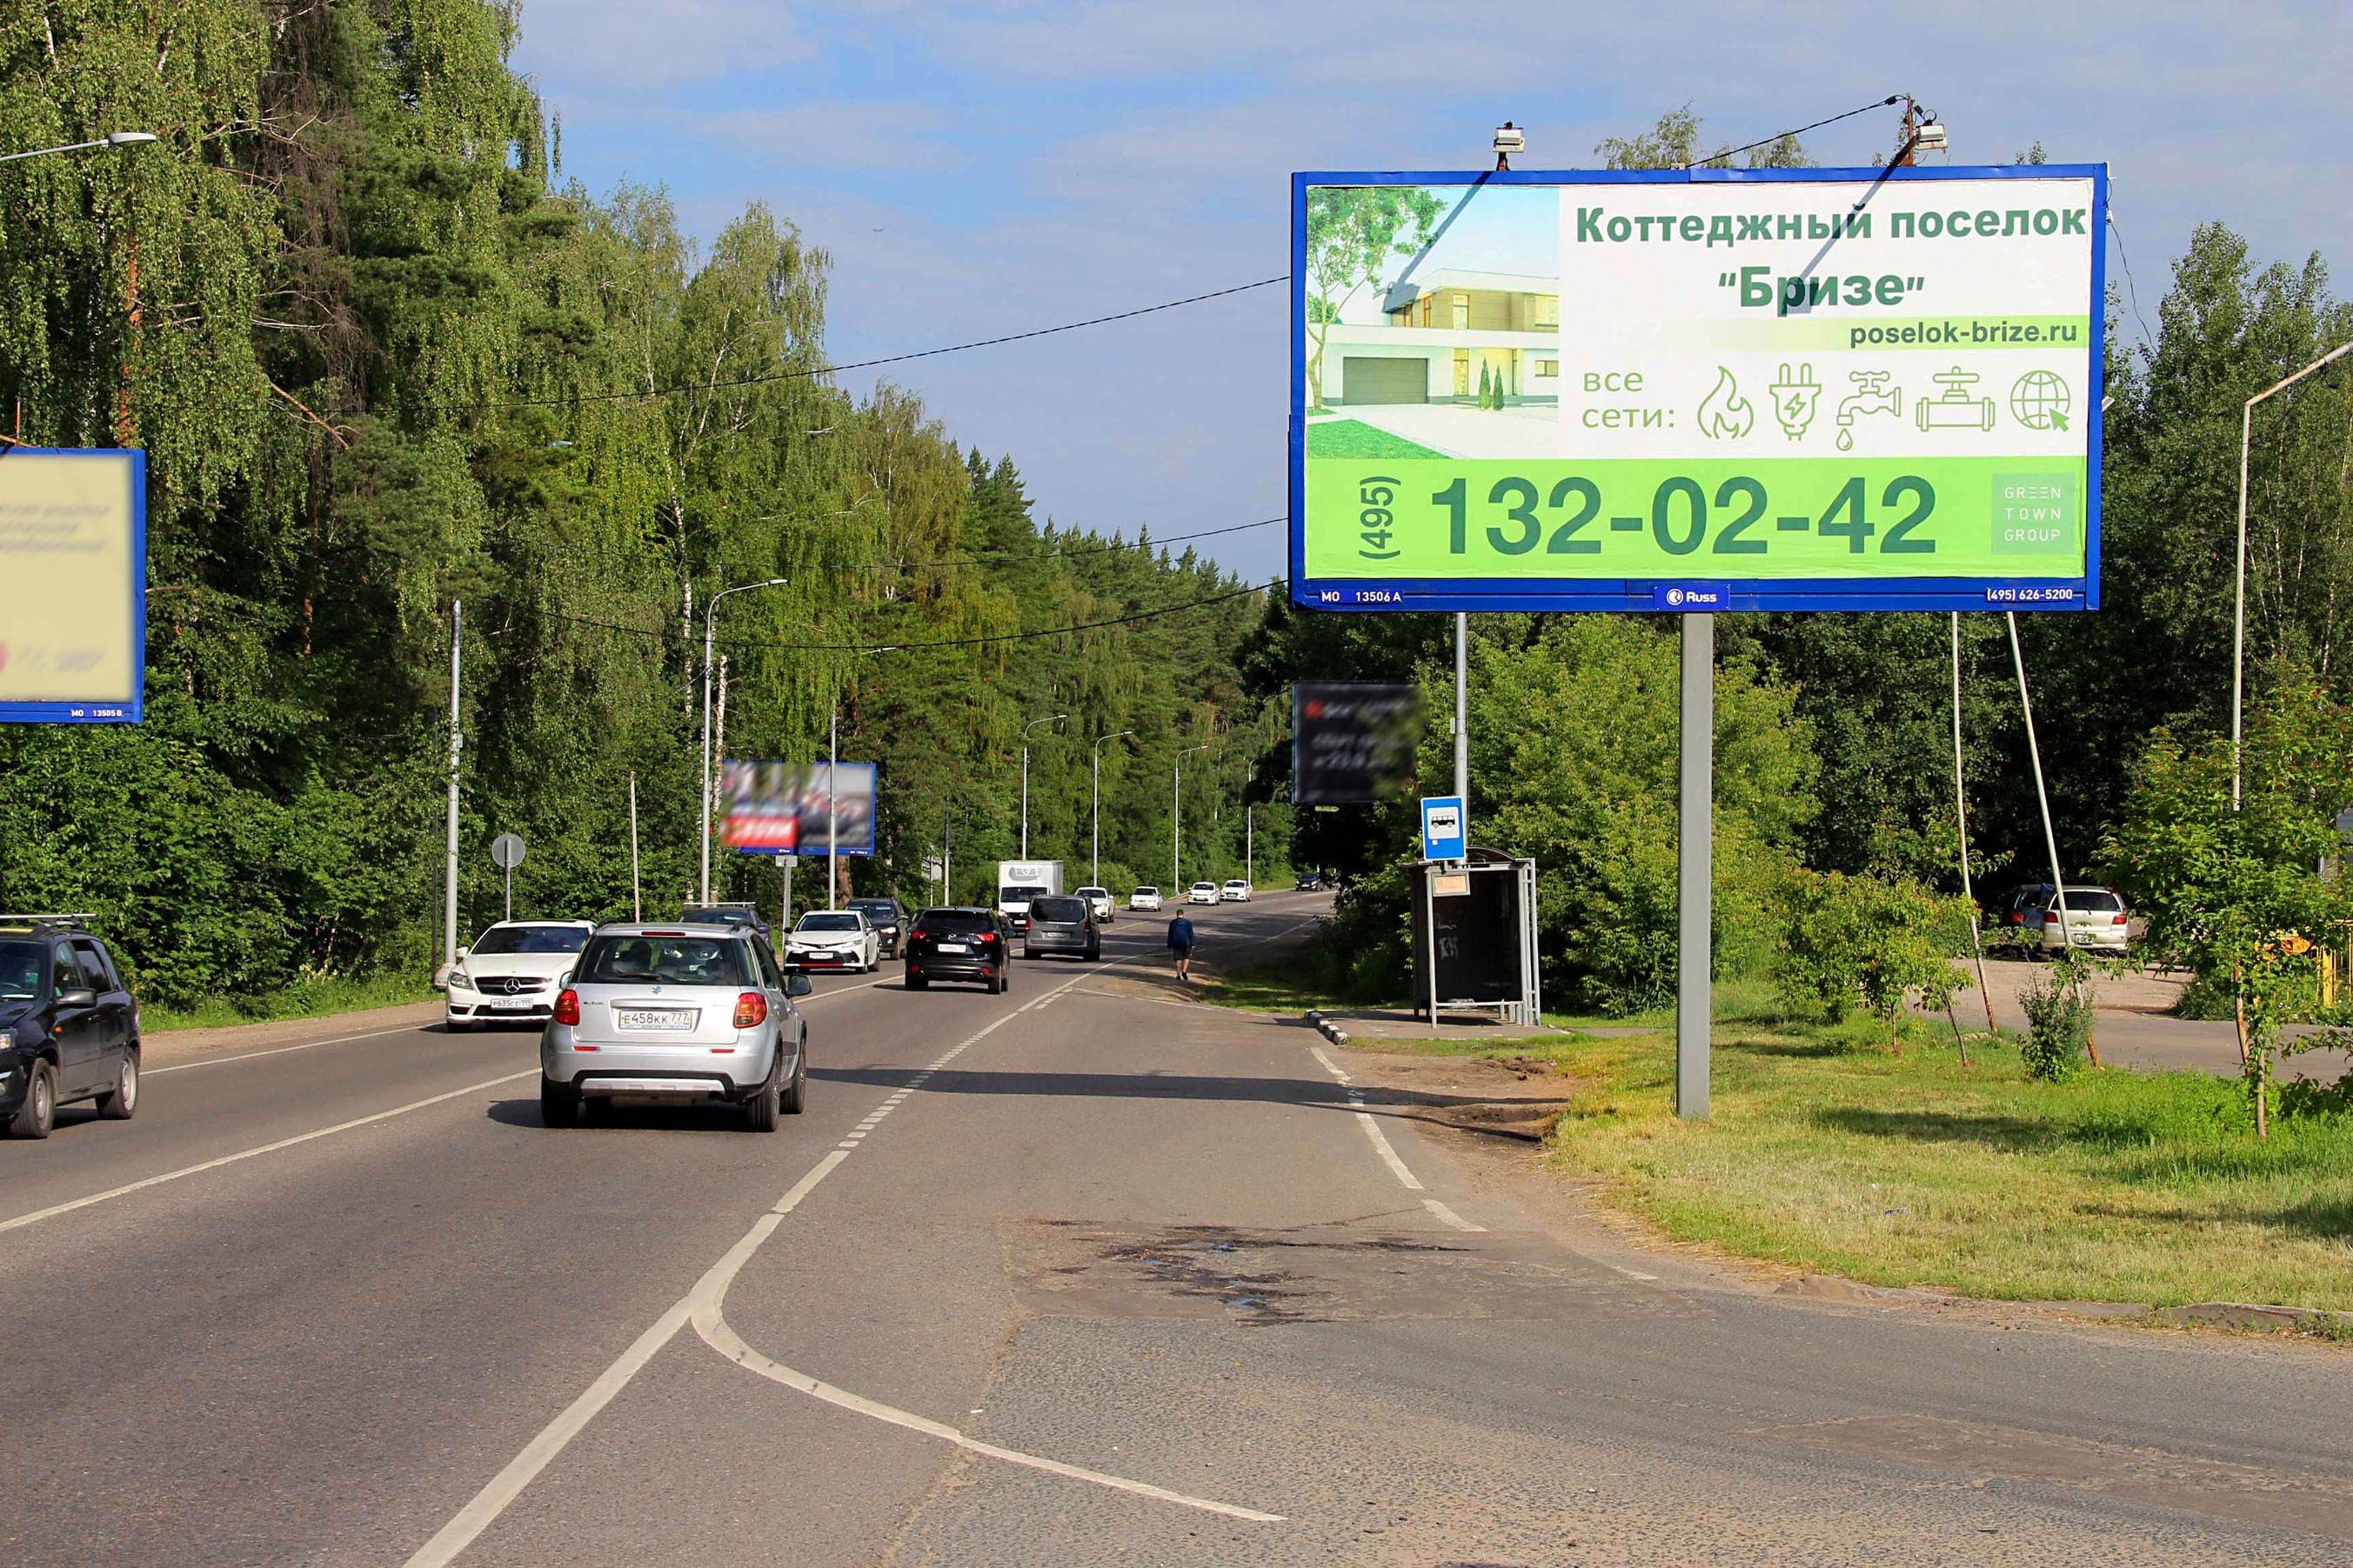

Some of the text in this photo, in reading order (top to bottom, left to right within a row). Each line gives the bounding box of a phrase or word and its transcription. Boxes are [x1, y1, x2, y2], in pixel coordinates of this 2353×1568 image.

[1575, 203, 2087, 248] Коттеджный поселок
[1849, 320, 2077, 348] poselok-brize.ru
[1583, 372, 1643, 392] все
[1582, 409, 1675, 428] сети:
[2004, 487, 2061, 499] GREEN
[1359, 475, 1937, 559] (495) 132-02-42
[2004, 508, 2061, 520] TOWN
[2004, 529, 2060, 541] GROUP
[1686, 591, 1717, 603] Russ
[1987, 589, 2073, 601] (495) 626-5200
